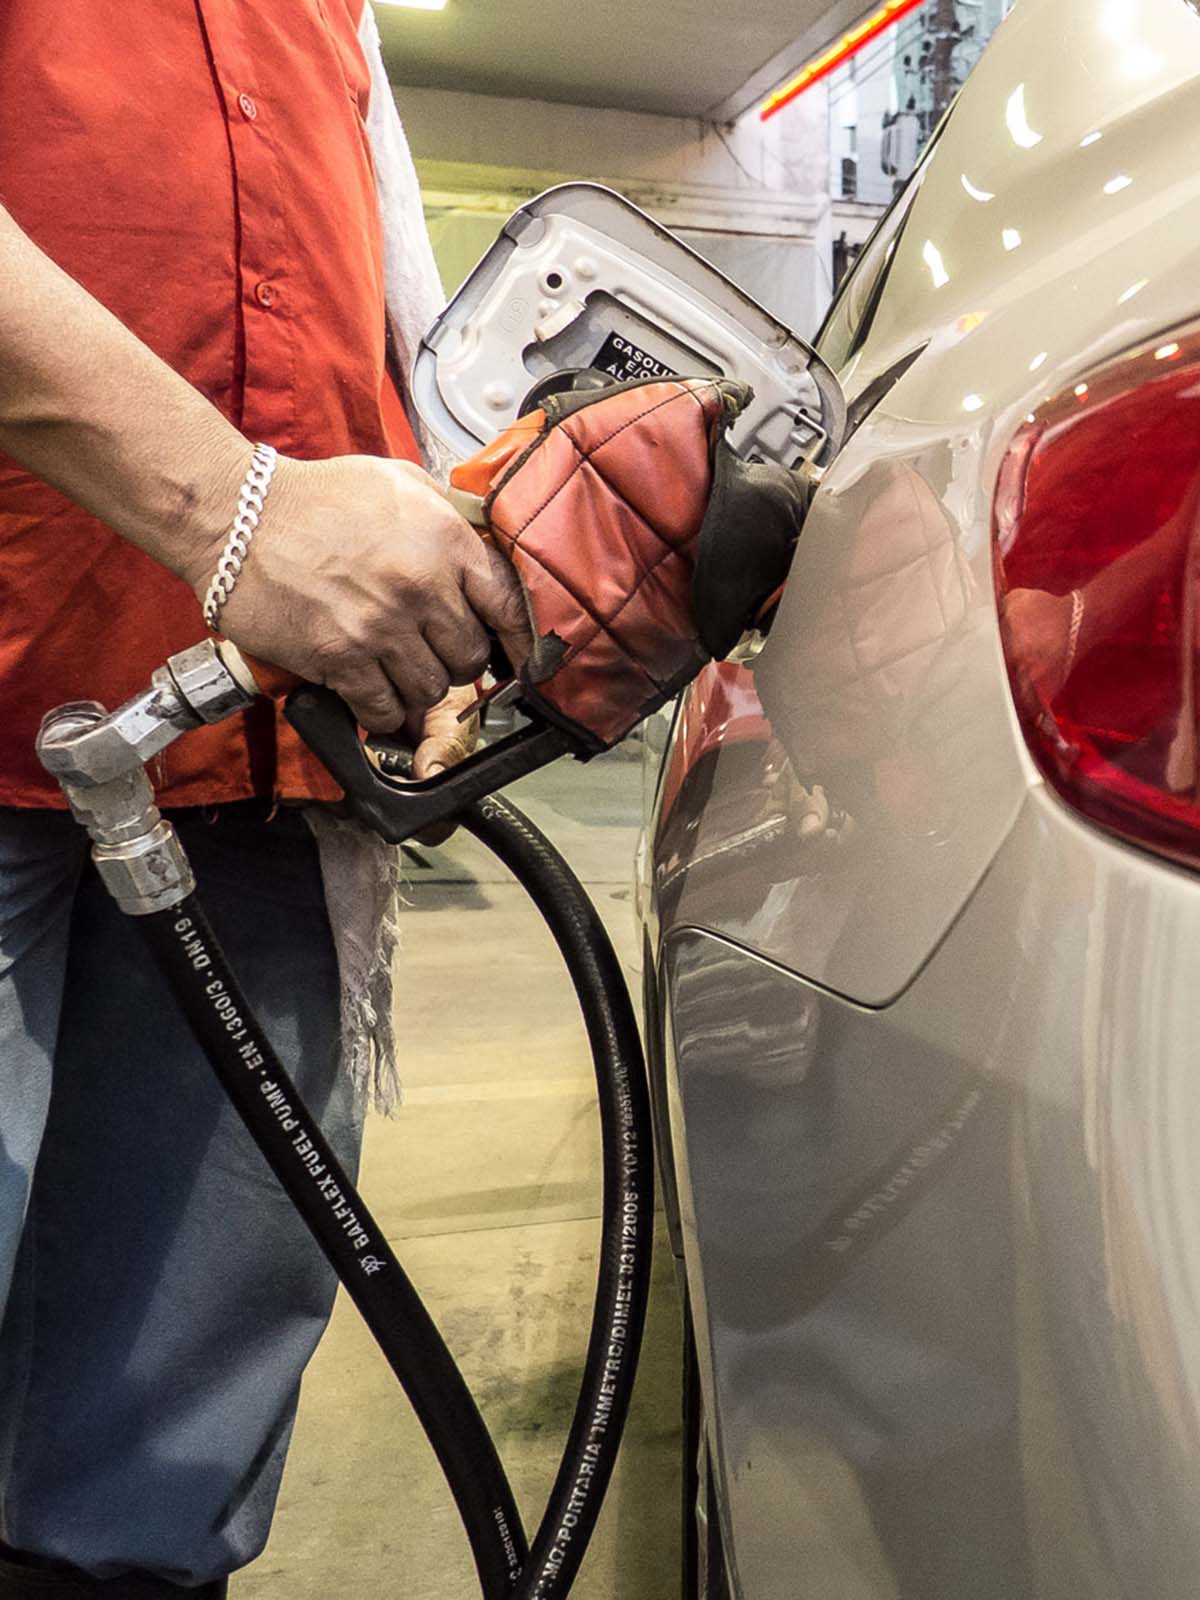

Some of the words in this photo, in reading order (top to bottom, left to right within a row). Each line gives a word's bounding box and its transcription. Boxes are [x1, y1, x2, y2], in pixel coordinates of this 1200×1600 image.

[612, 337, 673, 377] GASOLI
[173, 916, 212, 971] DN19
[205, 979, 249, 1041] 1360/3
[237, 1040, 265, 1070] EN
[260, 1080, 300, 1132] PUMP
[291, 1129, 327, 1177] FUEL
[316, 1173, 371, 1251] BALFLEX
